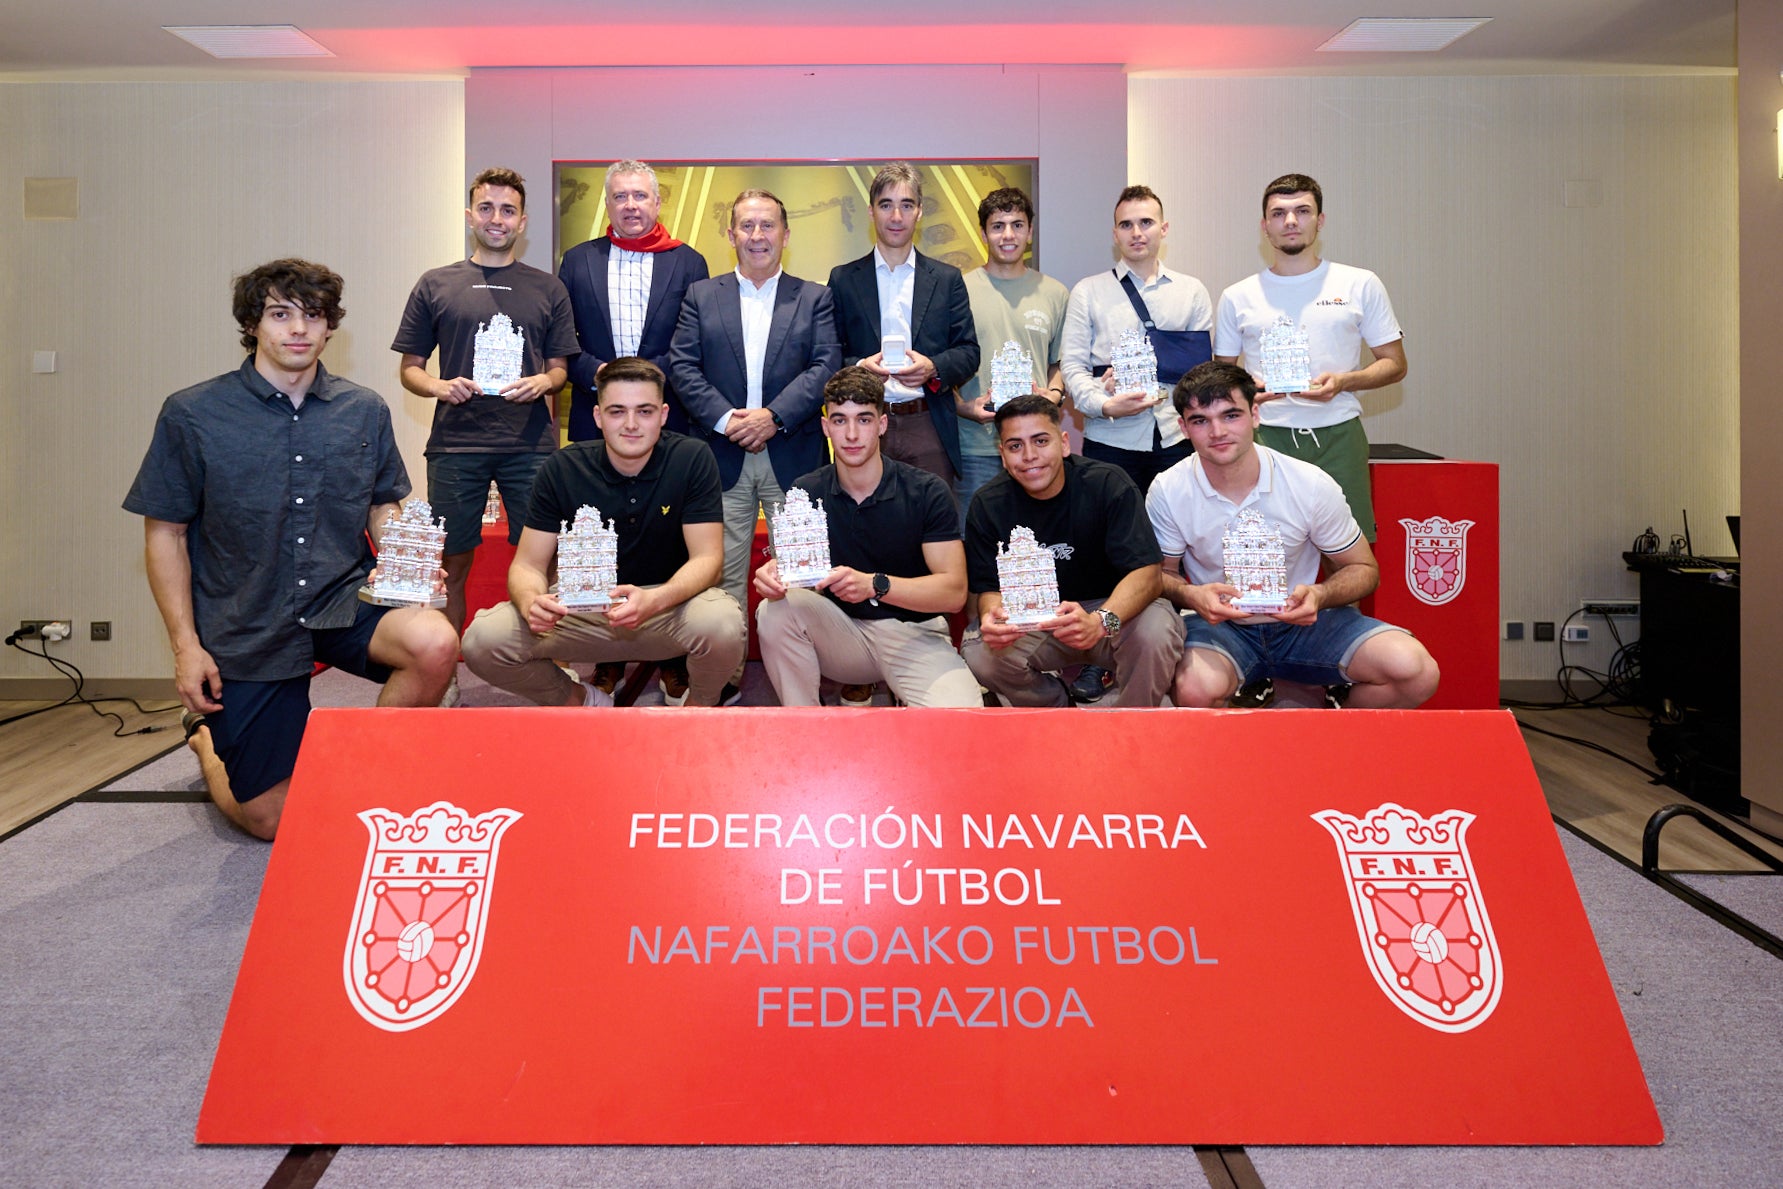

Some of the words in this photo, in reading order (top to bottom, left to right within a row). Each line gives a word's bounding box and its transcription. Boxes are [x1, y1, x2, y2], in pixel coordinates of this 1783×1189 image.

[628, 806, 944, 849] FEDERACIÓN
[962, 813, 1207, 849] NAVARRA
[779, 868, 843, 905] DE
[863, 860, 1061, 906] FÚTBOL
[627, 926, 994, 965] NAFARROAKO
[1013, 926, 1219, 965] FUTBOL
[757, 987, 1094, 1028] FEDERAZIOA
